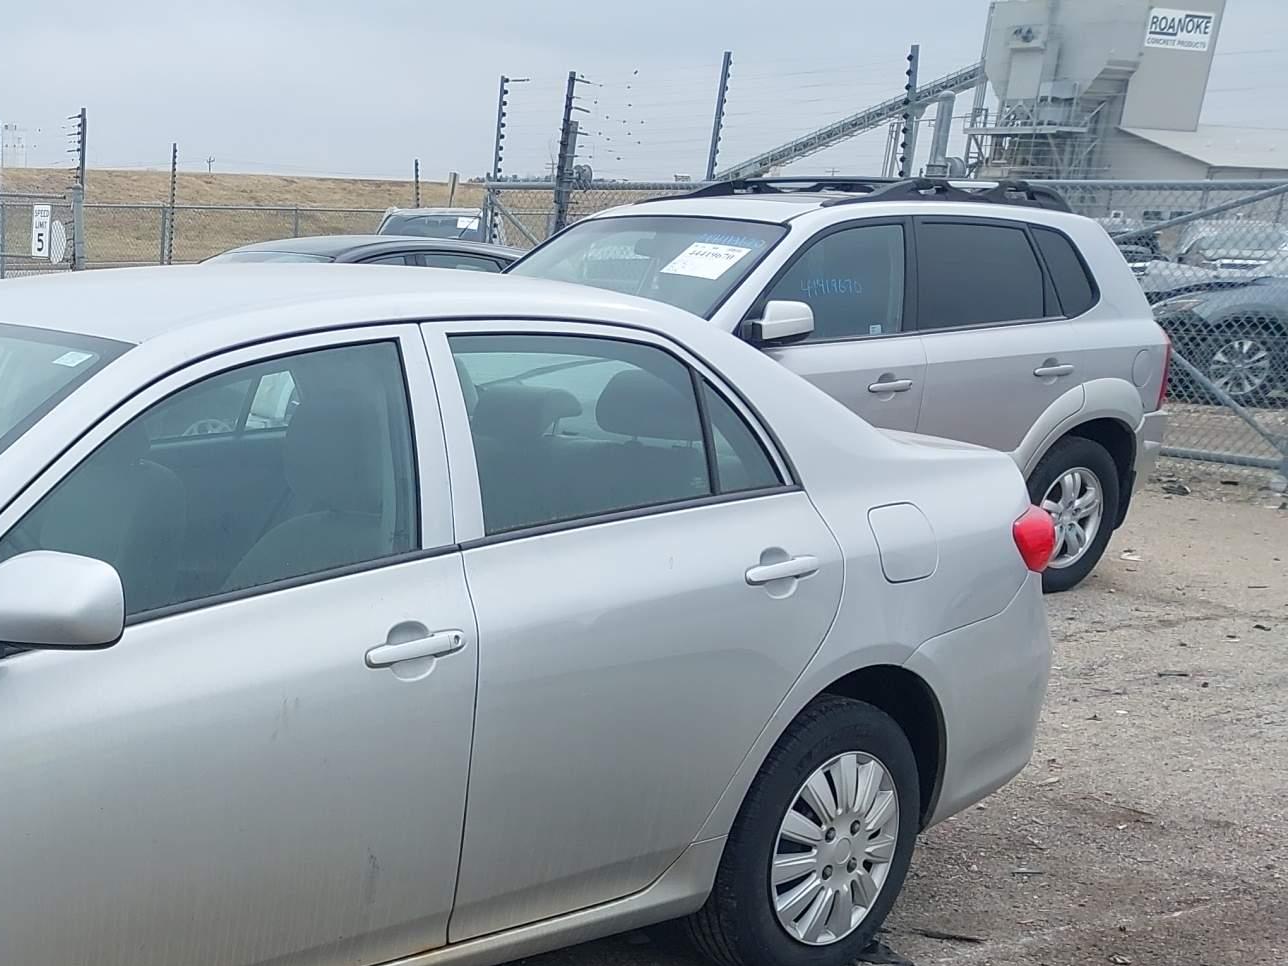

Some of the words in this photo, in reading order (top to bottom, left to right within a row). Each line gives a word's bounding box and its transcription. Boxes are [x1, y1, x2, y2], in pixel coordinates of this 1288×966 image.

[1150, 15, 1211, 35] ROANOKE
[34, 209, 49, 218] SPEED
[35, 221, 48, 229] LIMIT
[37, 232, 44, 252] 5
